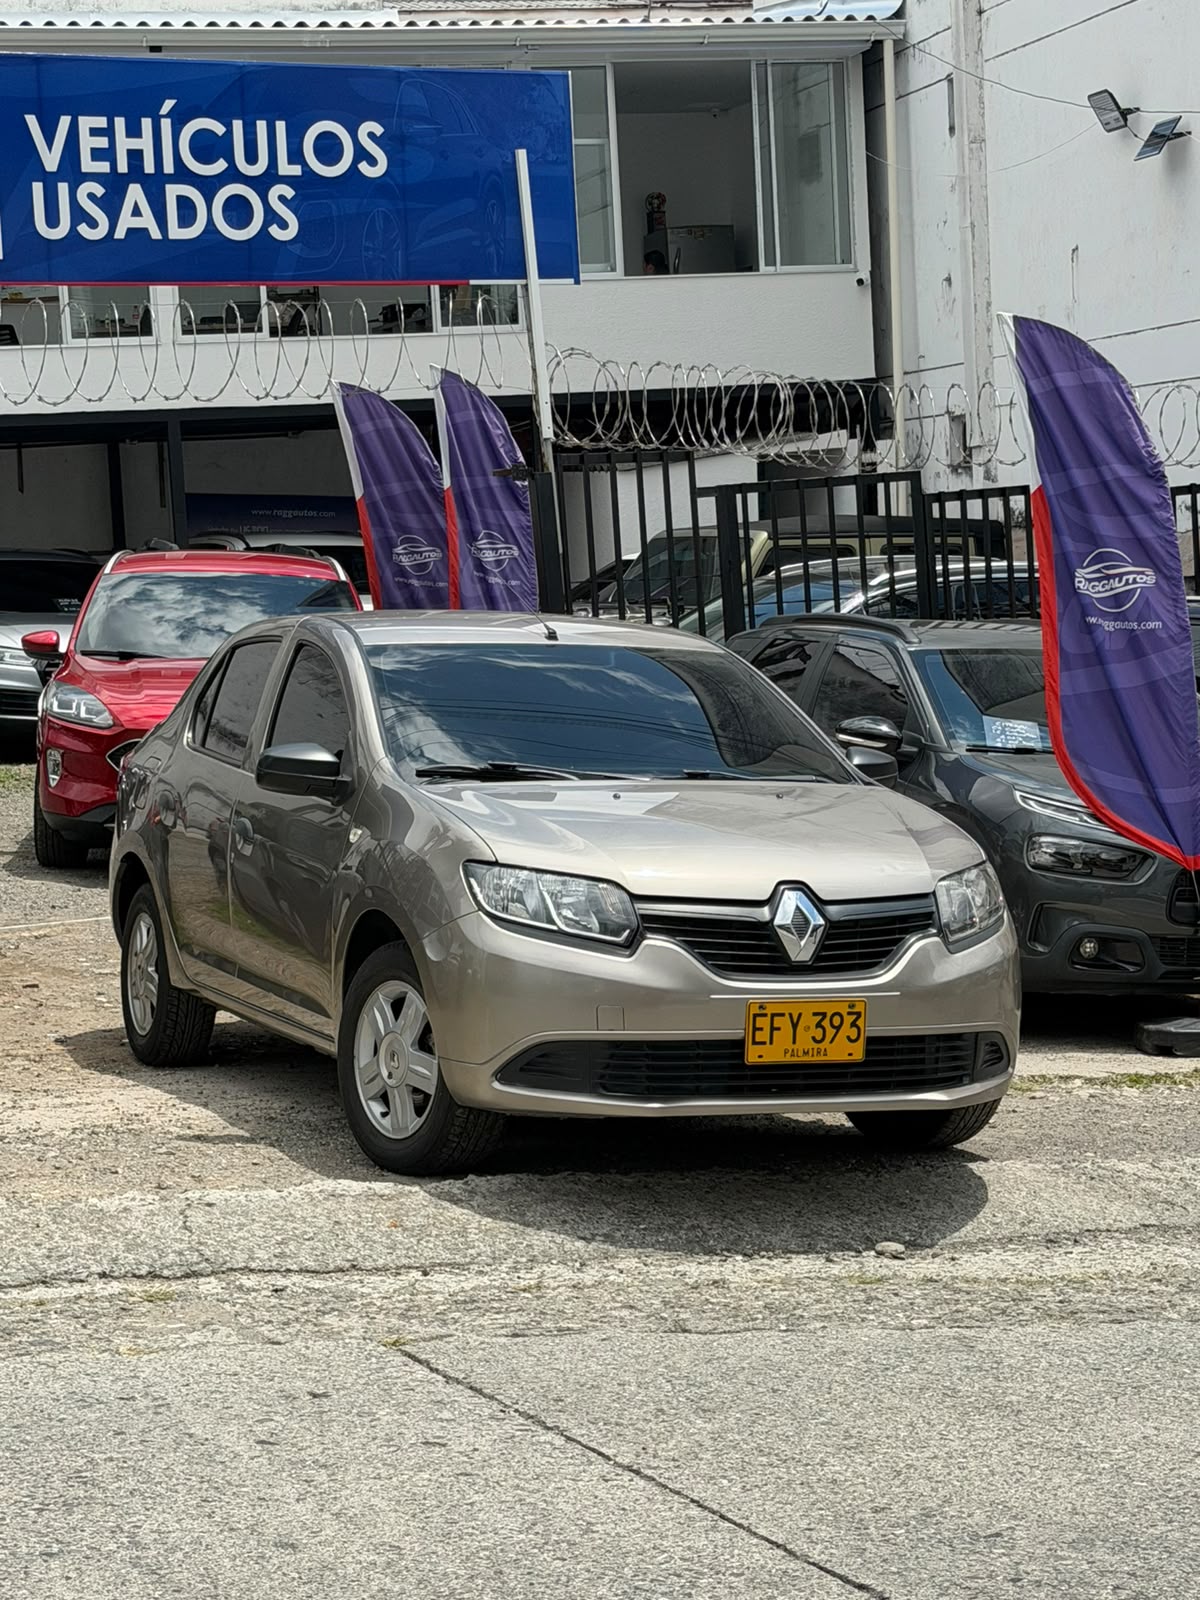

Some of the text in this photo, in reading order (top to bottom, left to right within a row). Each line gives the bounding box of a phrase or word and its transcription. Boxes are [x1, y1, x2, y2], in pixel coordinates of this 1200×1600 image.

[24, 99, 389, 179] VEHÍCULOS
[32, 181, 299, 241] USADOS
[751, 1010, 863, 1046] EFY 393
[783, 1046, 828, 1058] PALMIRA
